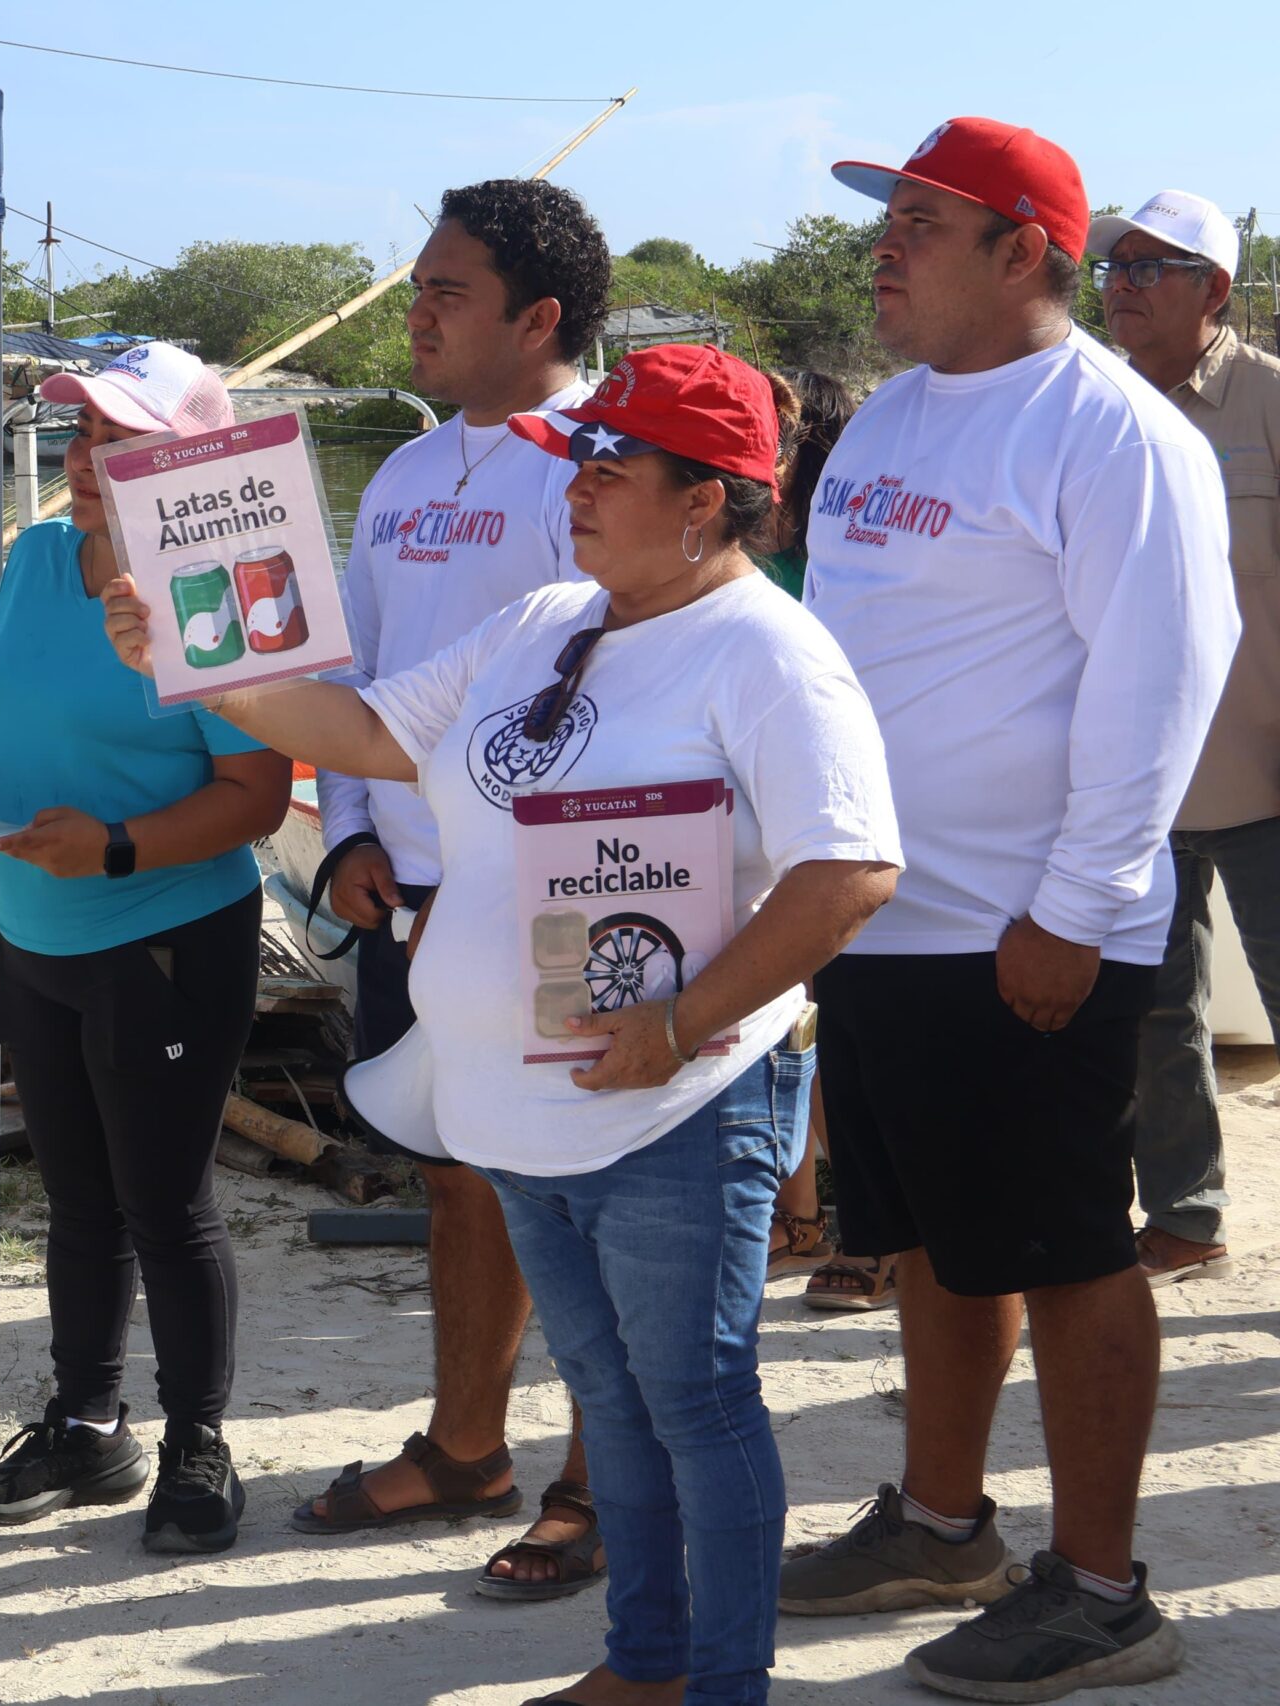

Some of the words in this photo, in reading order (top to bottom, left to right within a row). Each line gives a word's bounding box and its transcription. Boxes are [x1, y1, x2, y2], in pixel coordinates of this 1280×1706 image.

[230, 430, 248, 441] SDS
[174, 441, 224, 460] YUCATÁN
[156, 490, 233, 523] Latas
[240, 475, 275, 503] de
[817, 477, 856, 518] SAN
[863, 488, 952, 538] CRISANTO
[159, 501, 287, 551] Aluminio
[370, 511, 402, 548] SAN
[416, 510, 505, 546] CRISANTO
[844, 522, 889, 547] Enamora
[398, 544, 450, 562] Enamora
[585, 800, 637, 812] YUCATÁN
[645, 792, 663, 801] SDS
[596, 838, 640, 865] No
[548, 862, 691, 897] reciclable
